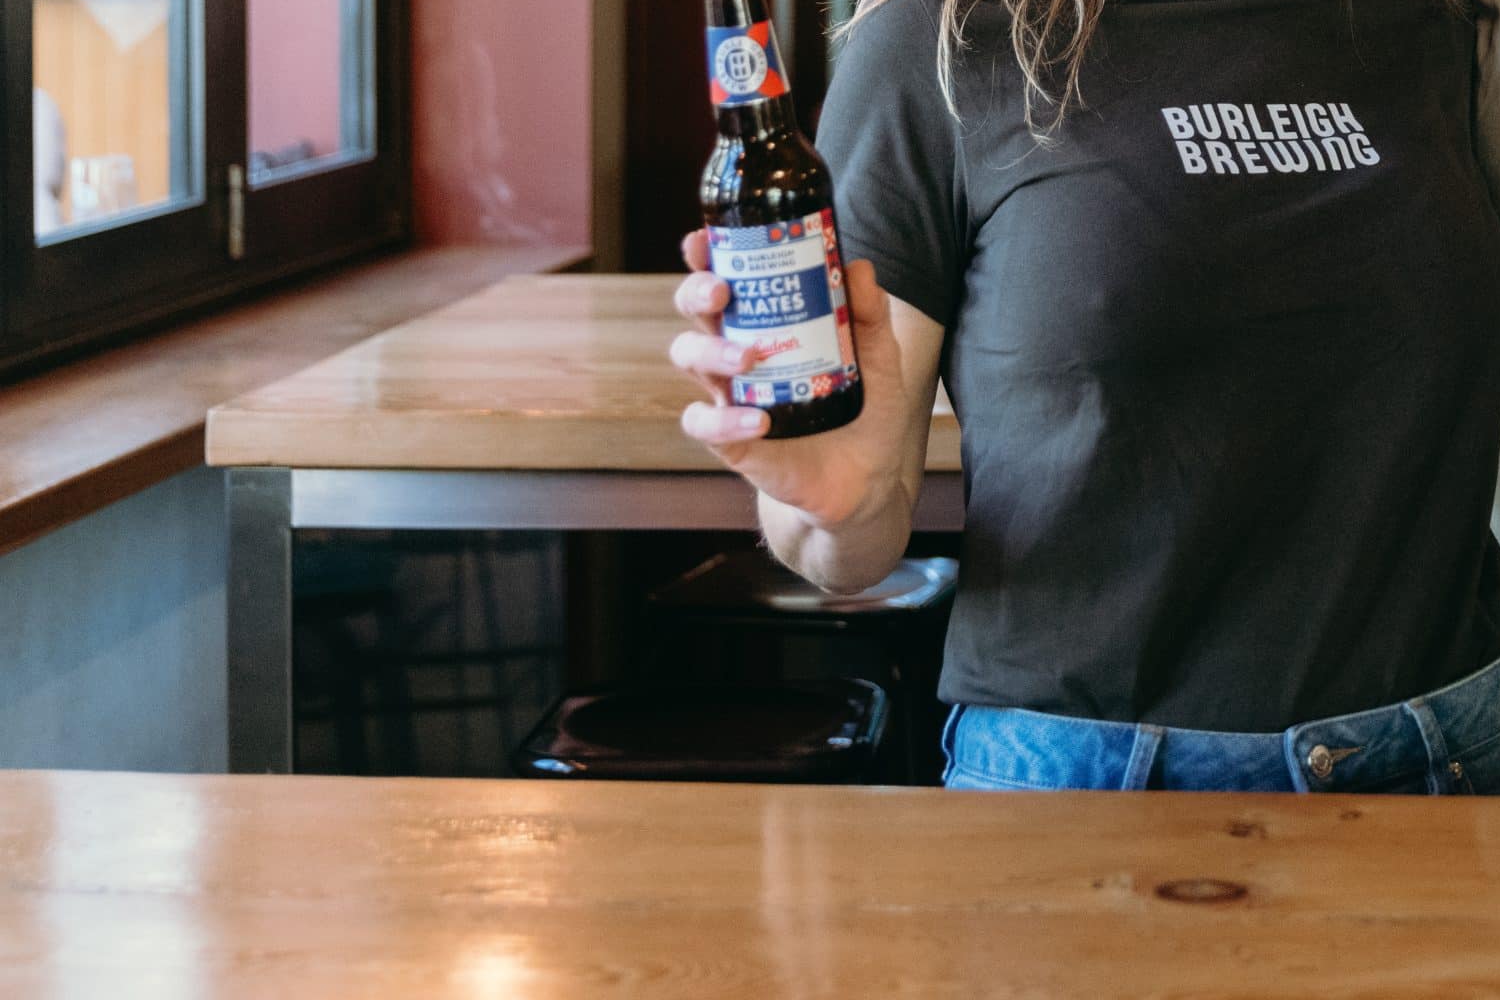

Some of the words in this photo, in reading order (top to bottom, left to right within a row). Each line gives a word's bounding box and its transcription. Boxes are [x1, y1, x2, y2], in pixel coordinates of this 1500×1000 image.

[1160, 102, 1365, 141] BURLEIGH
[1175, 132, 1381, 175] BREWING
[734, 274, 801, 299] CZECH
[737, 292, 806, 317] MATES
